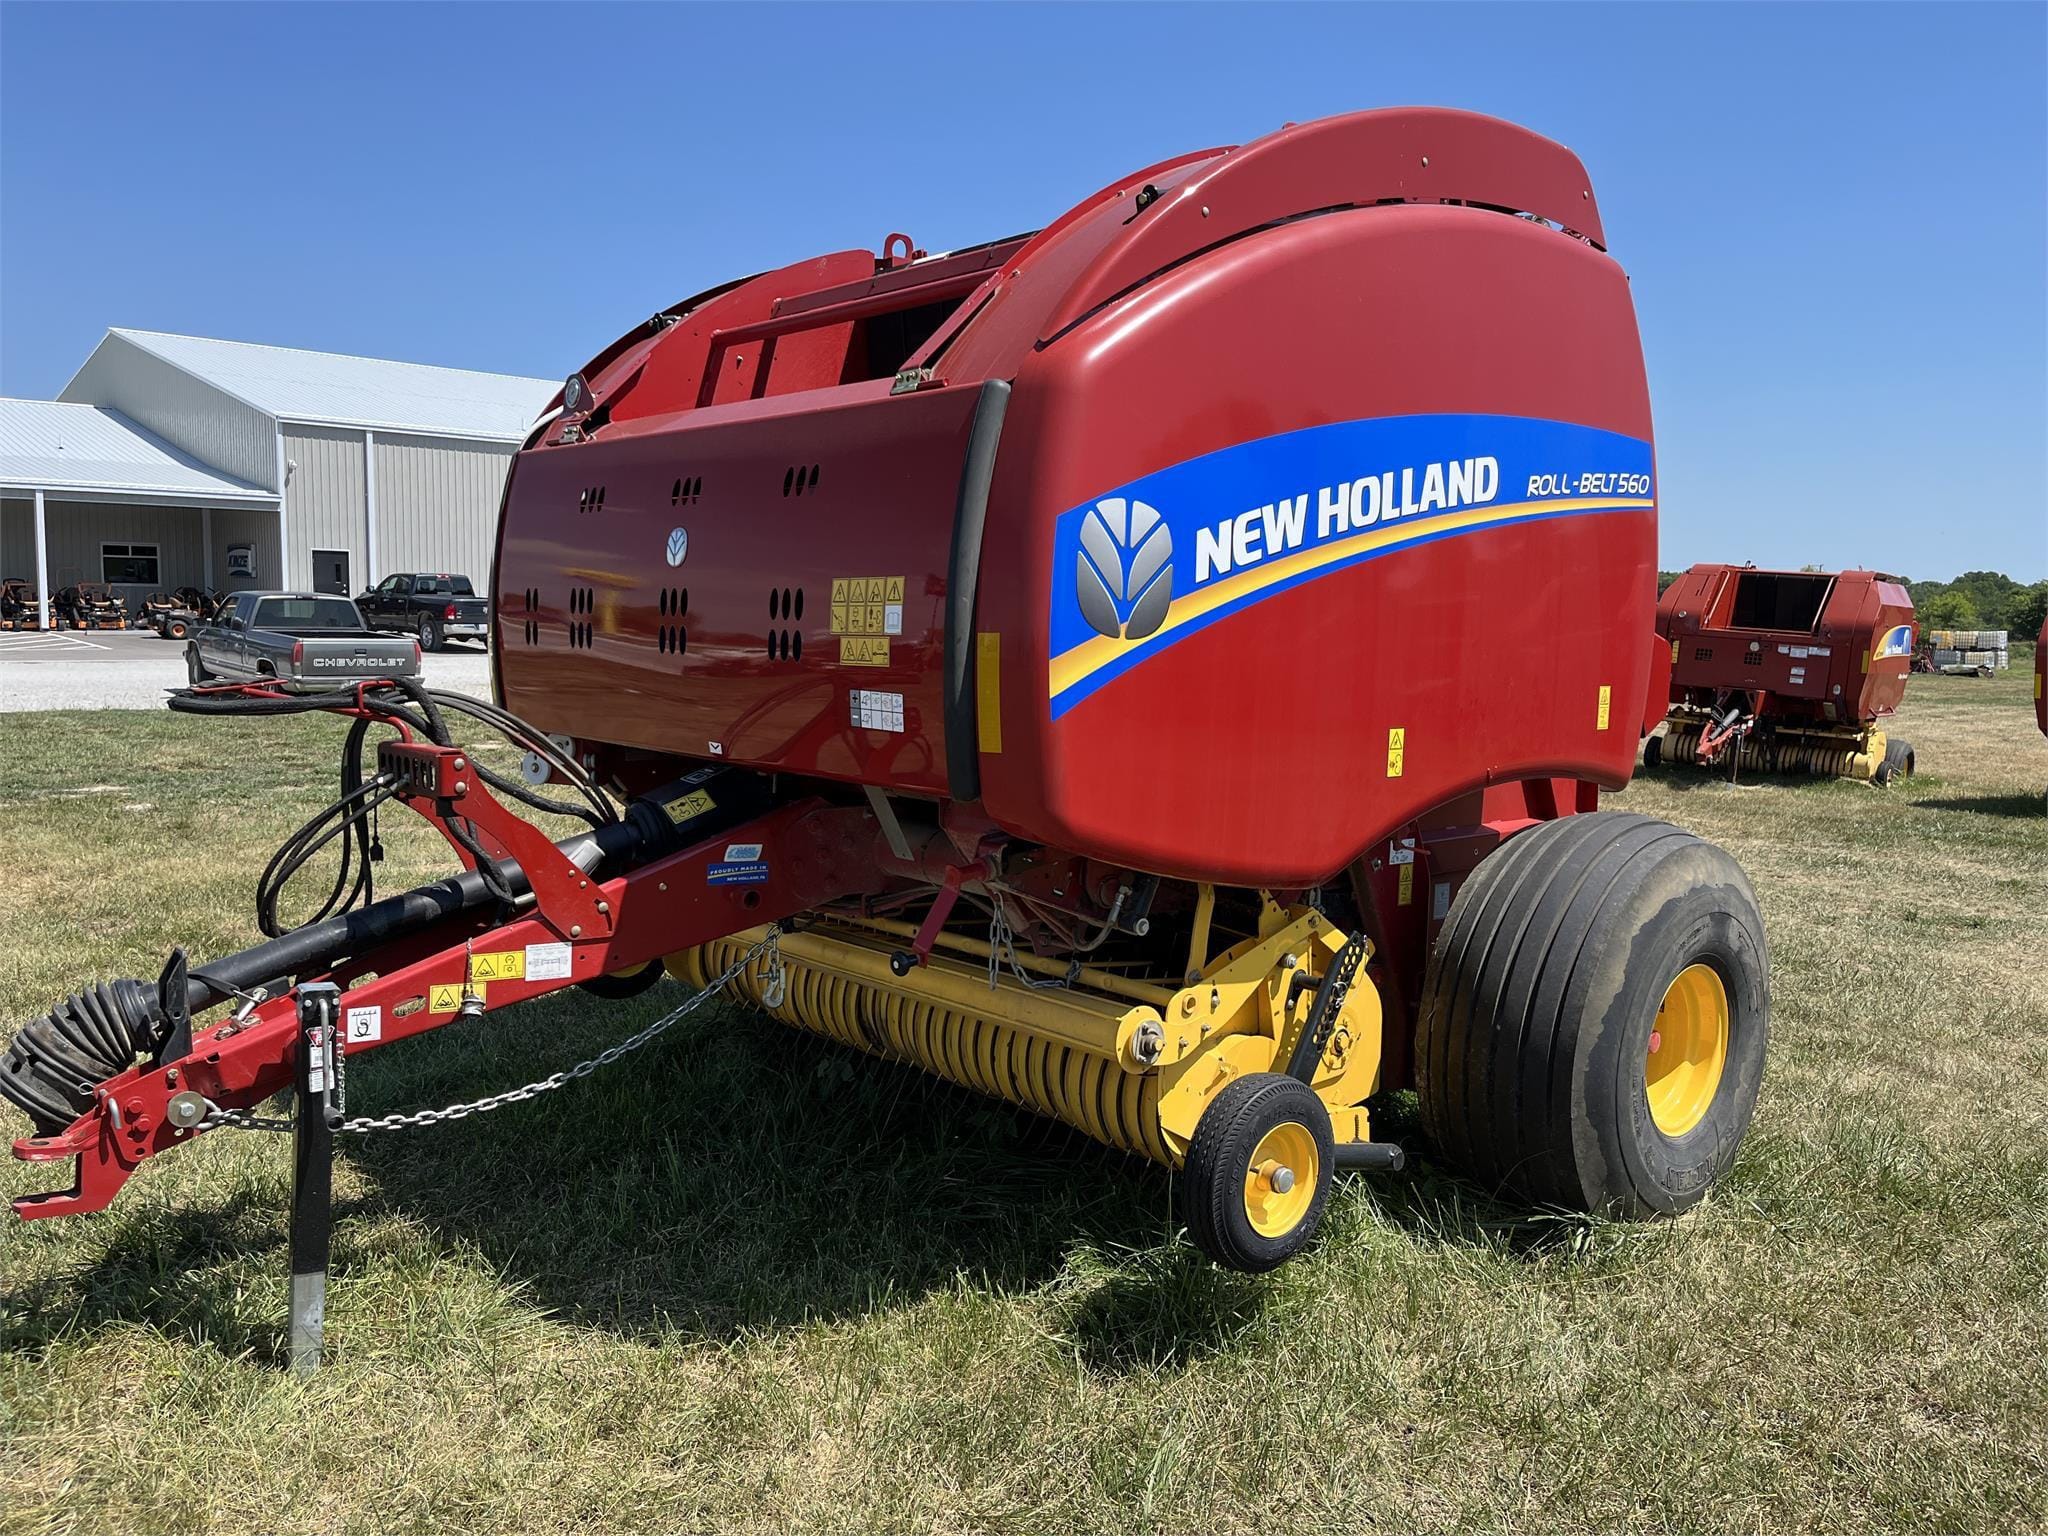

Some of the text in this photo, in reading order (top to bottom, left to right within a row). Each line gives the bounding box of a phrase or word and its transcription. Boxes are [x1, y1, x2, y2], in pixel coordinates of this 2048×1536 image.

[1195, 456, 1499, 583] NEW HOLLAND
[313, 657, 406, 667] CHEVROLET
[710, 867, 739, 875] PROUDLY
